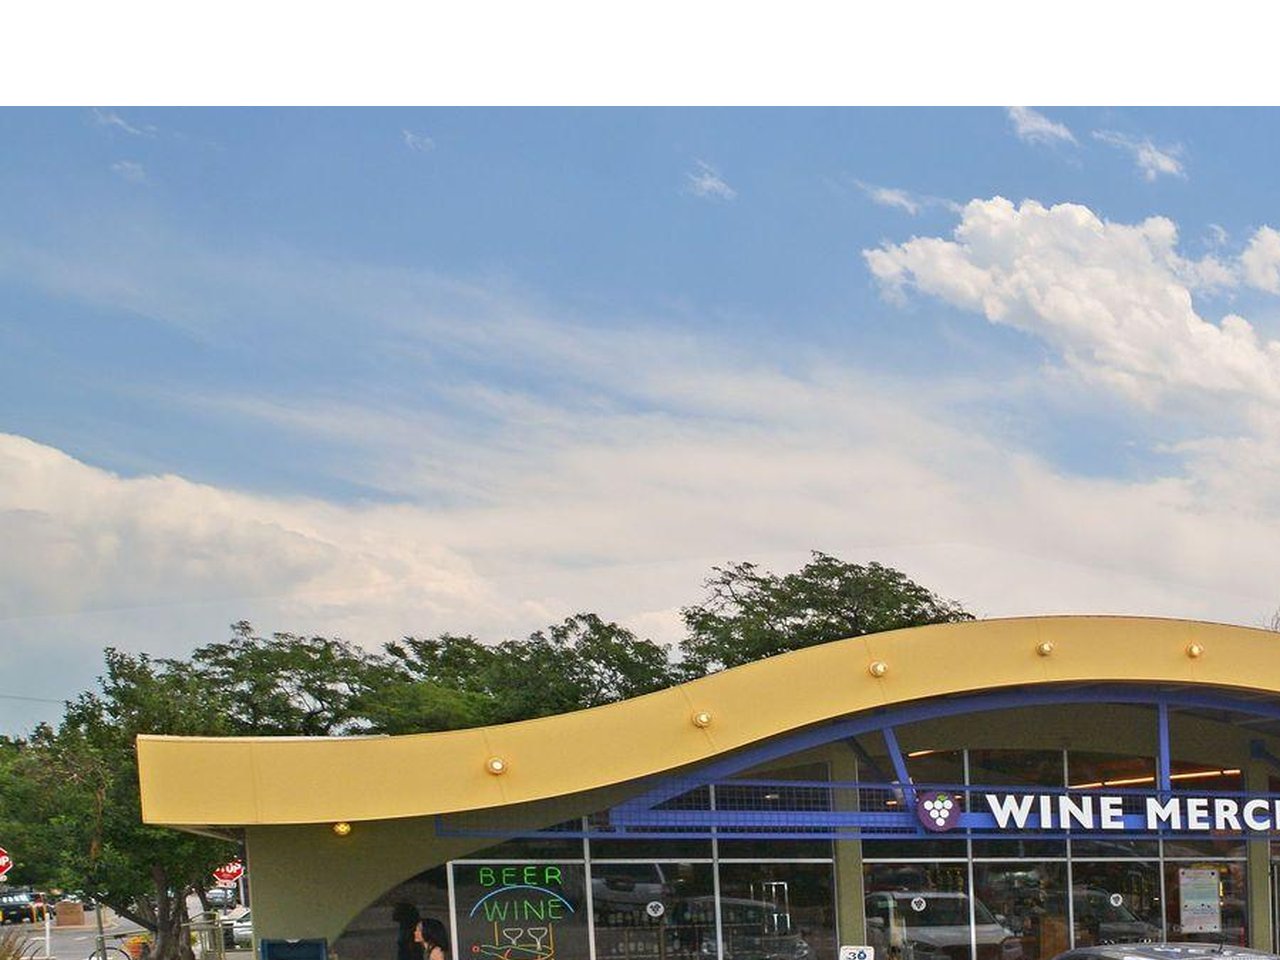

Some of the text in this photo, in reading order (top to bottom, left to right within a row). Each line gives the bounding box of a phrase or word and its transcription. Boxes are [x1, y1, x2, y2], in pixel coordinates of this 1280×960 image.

[986, 794, 1125, 829] WINE
[479, 866, 562, 887] BEER
[484, 899, 564, 922] WINE
